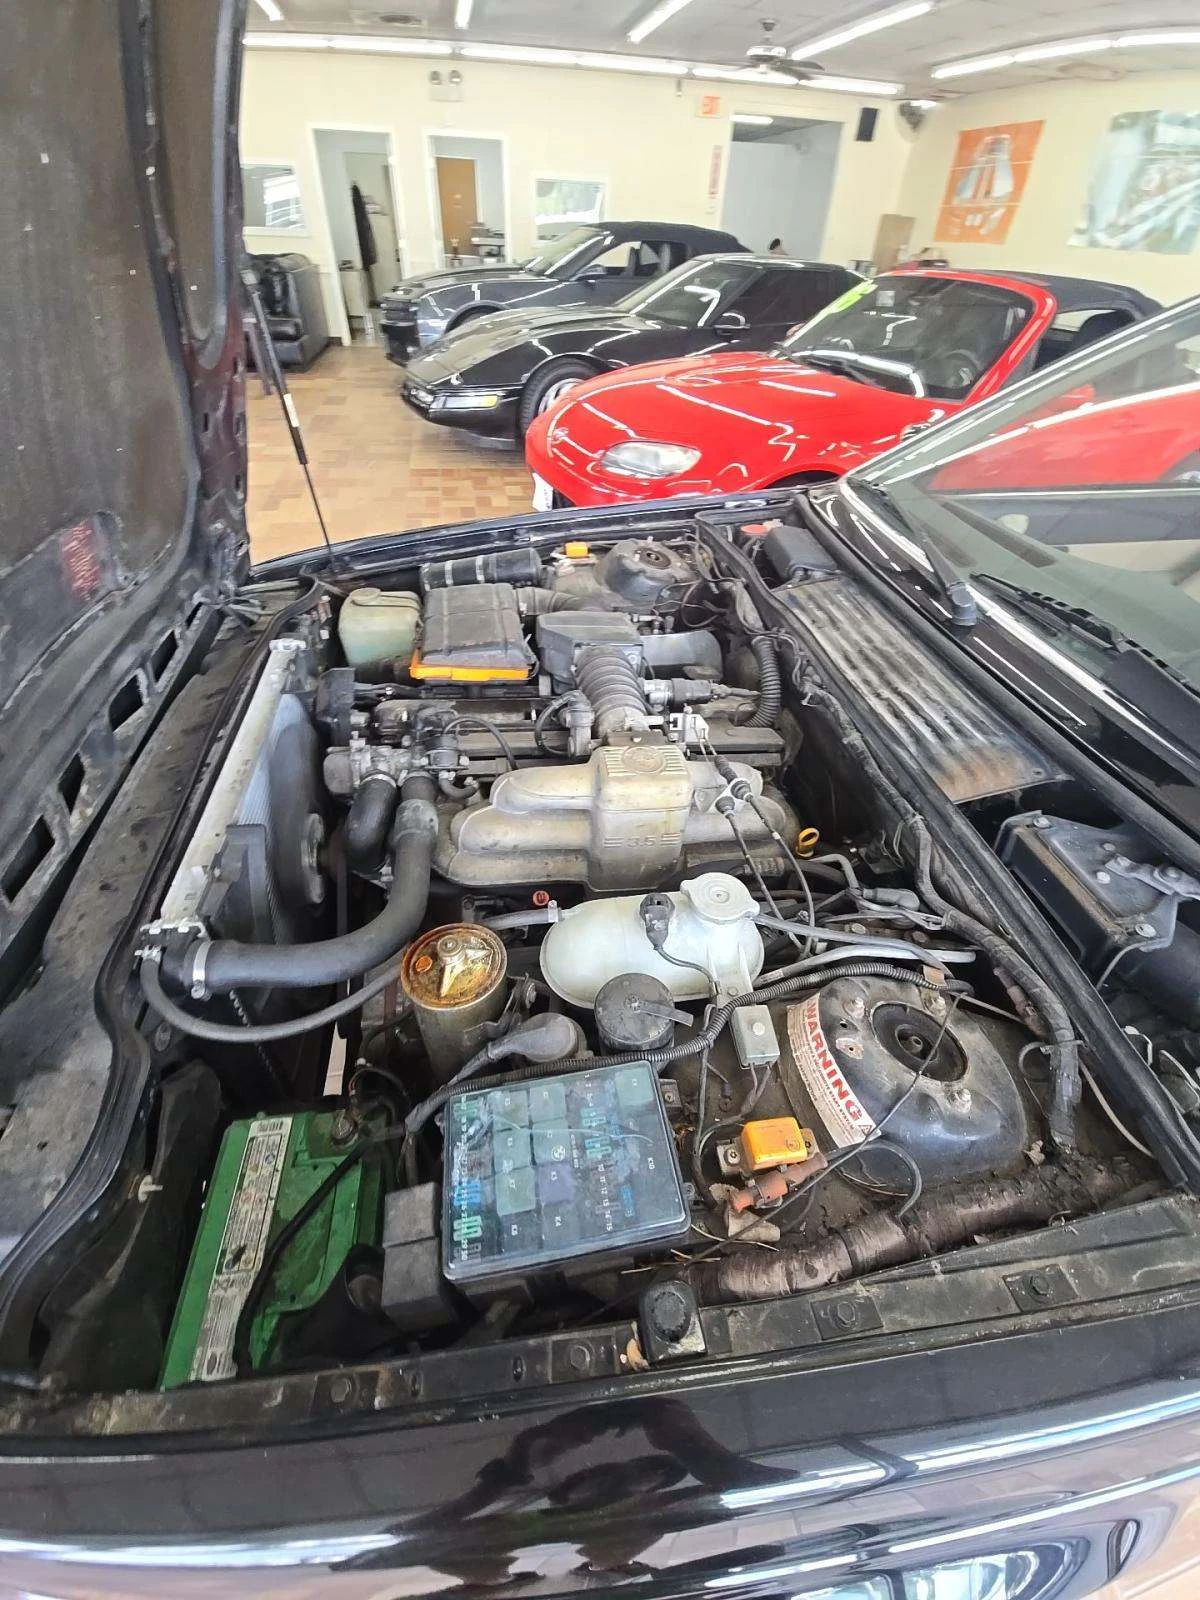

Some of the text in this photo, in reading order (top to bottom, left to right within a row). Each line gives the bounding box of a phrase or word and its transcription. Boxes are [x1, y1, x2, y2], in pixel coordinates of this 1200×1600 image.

[626, 836, 657, 848] 3.5
[806, 997, 863, 1121] WARNING
[646, 1156, 655, 1170] K10
